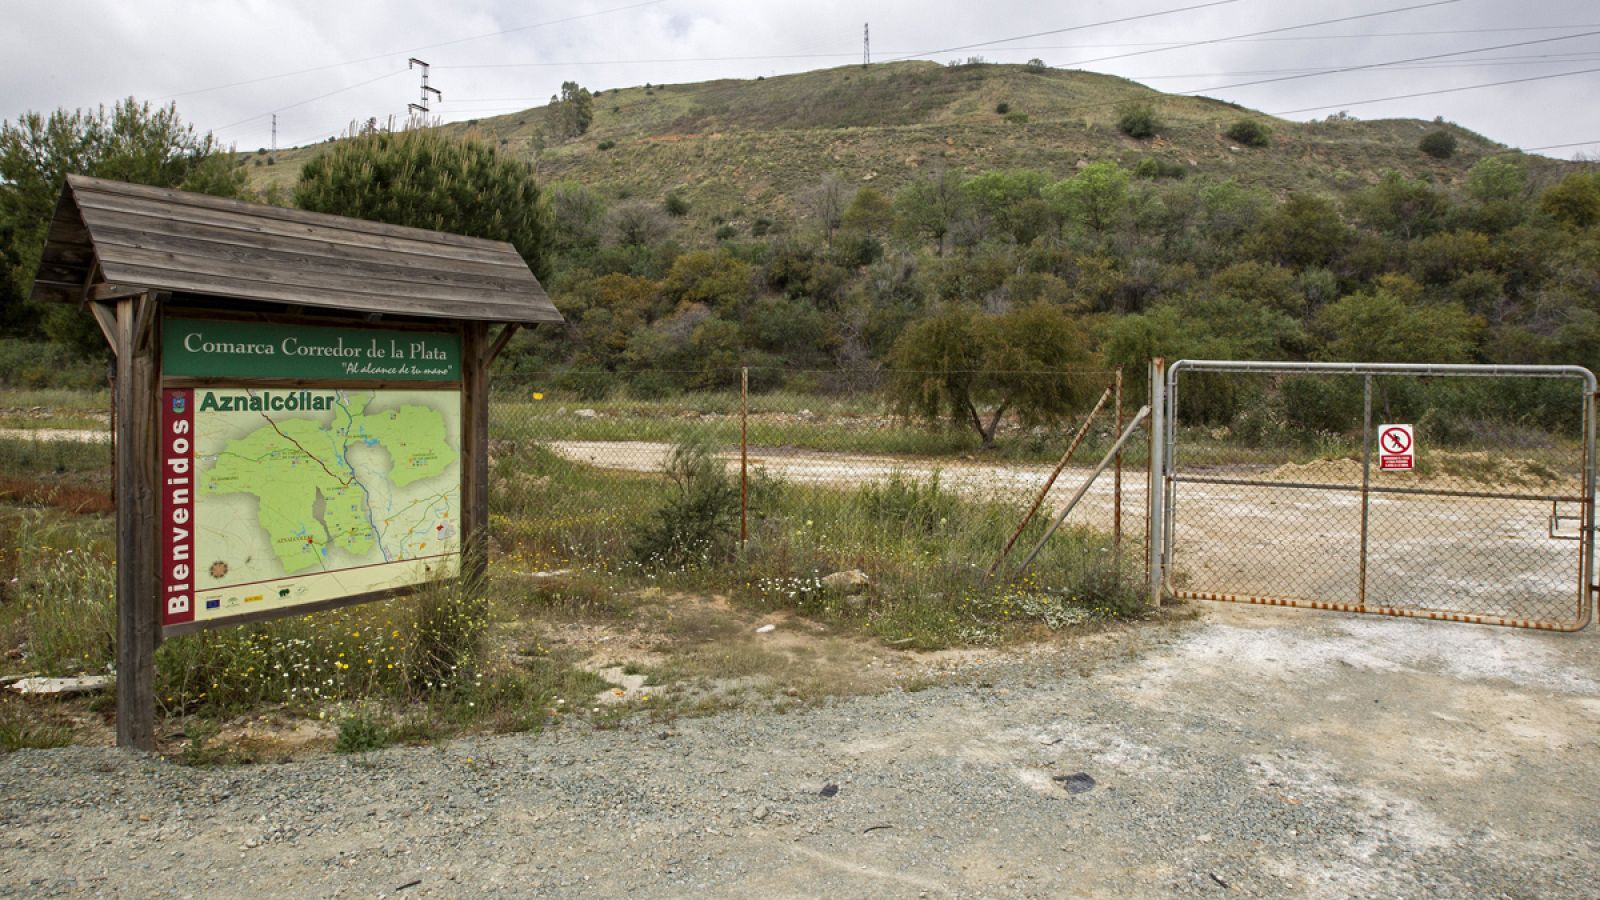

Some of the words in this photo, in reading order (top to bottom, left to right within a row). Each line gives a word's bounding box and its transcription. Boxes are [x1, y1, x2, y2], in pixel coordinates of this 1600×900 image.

[184, 332, 275, 355] Comarca
[281, 336, 362, 357] Corredor
[366, 338, 385, 358] de
[391, 339, 404, 359] la
[410, 340, 447, 361] Plata
[342, 361, 359, 375] "Al
[360, 362, 397, 374] alcance
[398, 363, 410, 374] de
[411, 364, 422, 374] tu
[423, 364, 453, 376] mano"
[200, 391, 335, 412] Aznalcóllar
[167, 419, 190, 615] Bienvenidos
